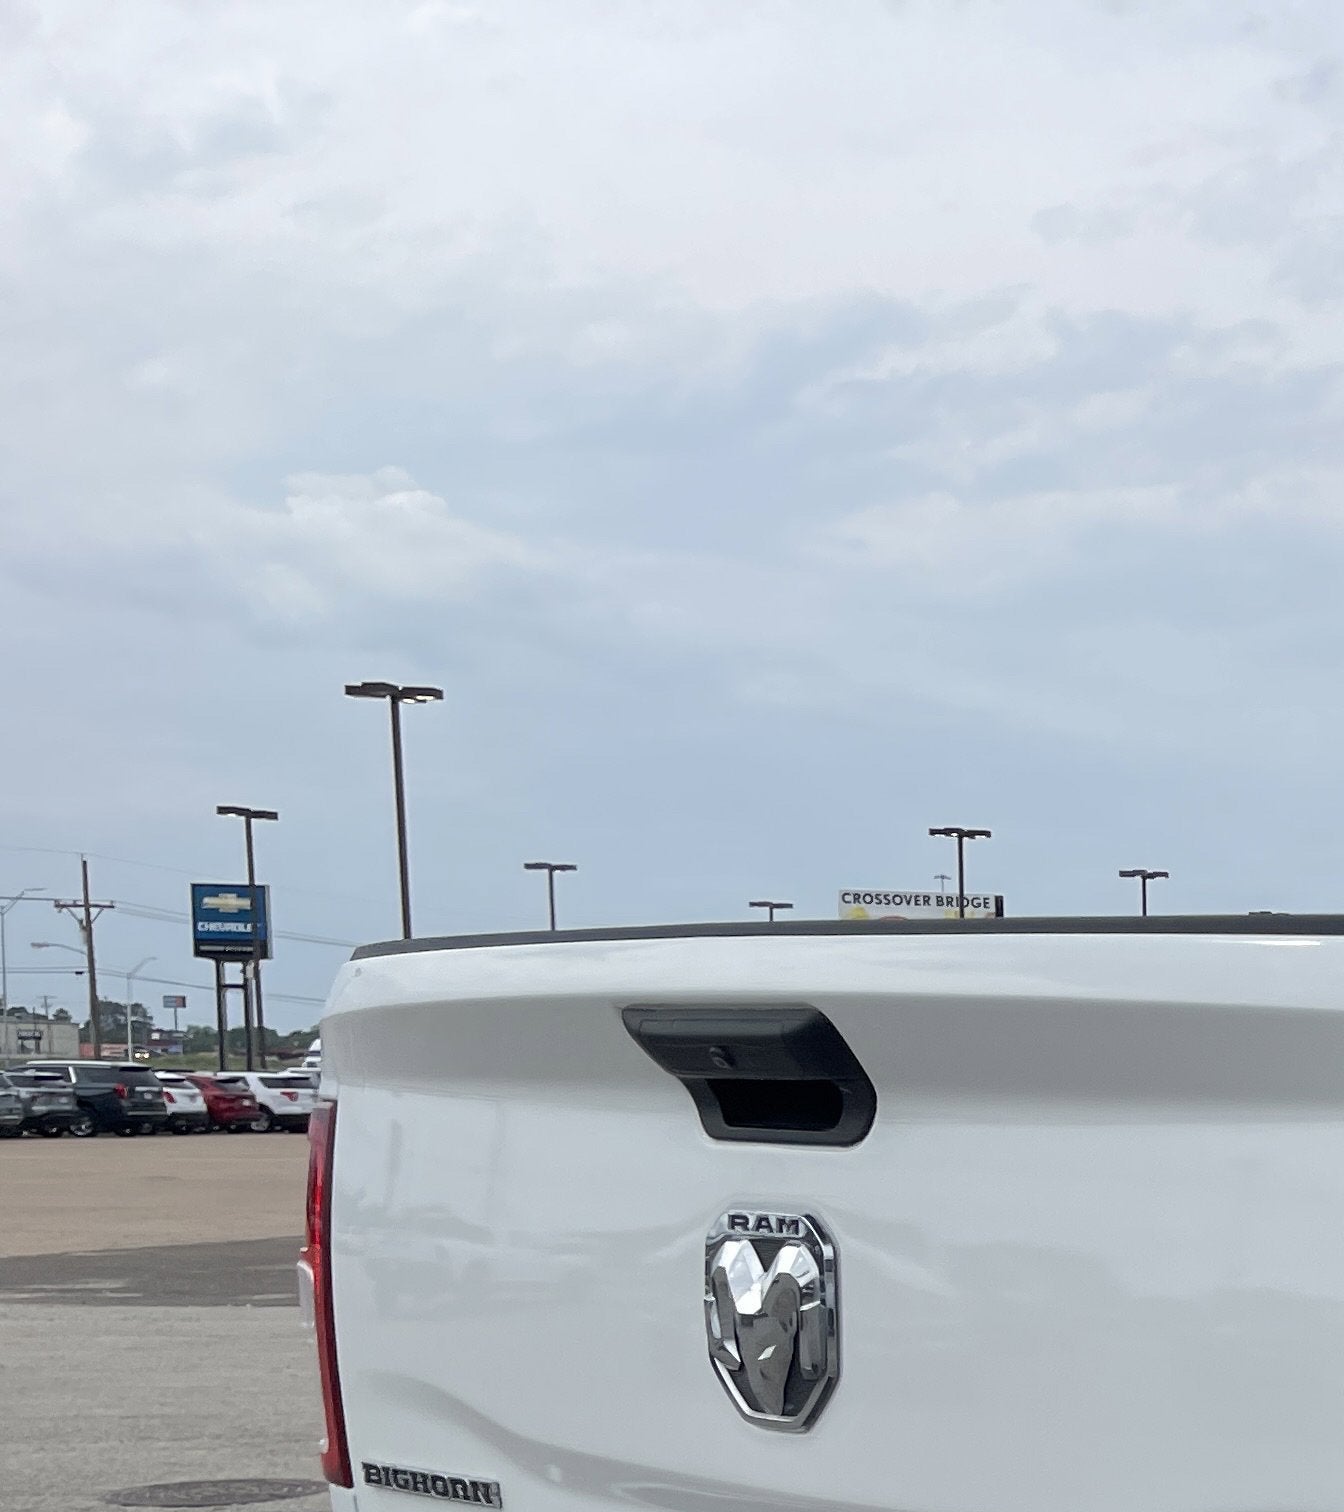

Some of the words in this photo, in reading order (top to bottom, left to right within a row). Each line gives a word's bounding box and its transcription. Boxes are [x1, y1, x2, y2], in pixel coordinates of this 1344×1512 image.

[841, 892, 932, 907] CROSSOVER
[197, 921, 262, 933] CHEVROLE
[727, 1213, 800, 1236] RAM
[362, 1462, 502, 1508] BIGHORN
